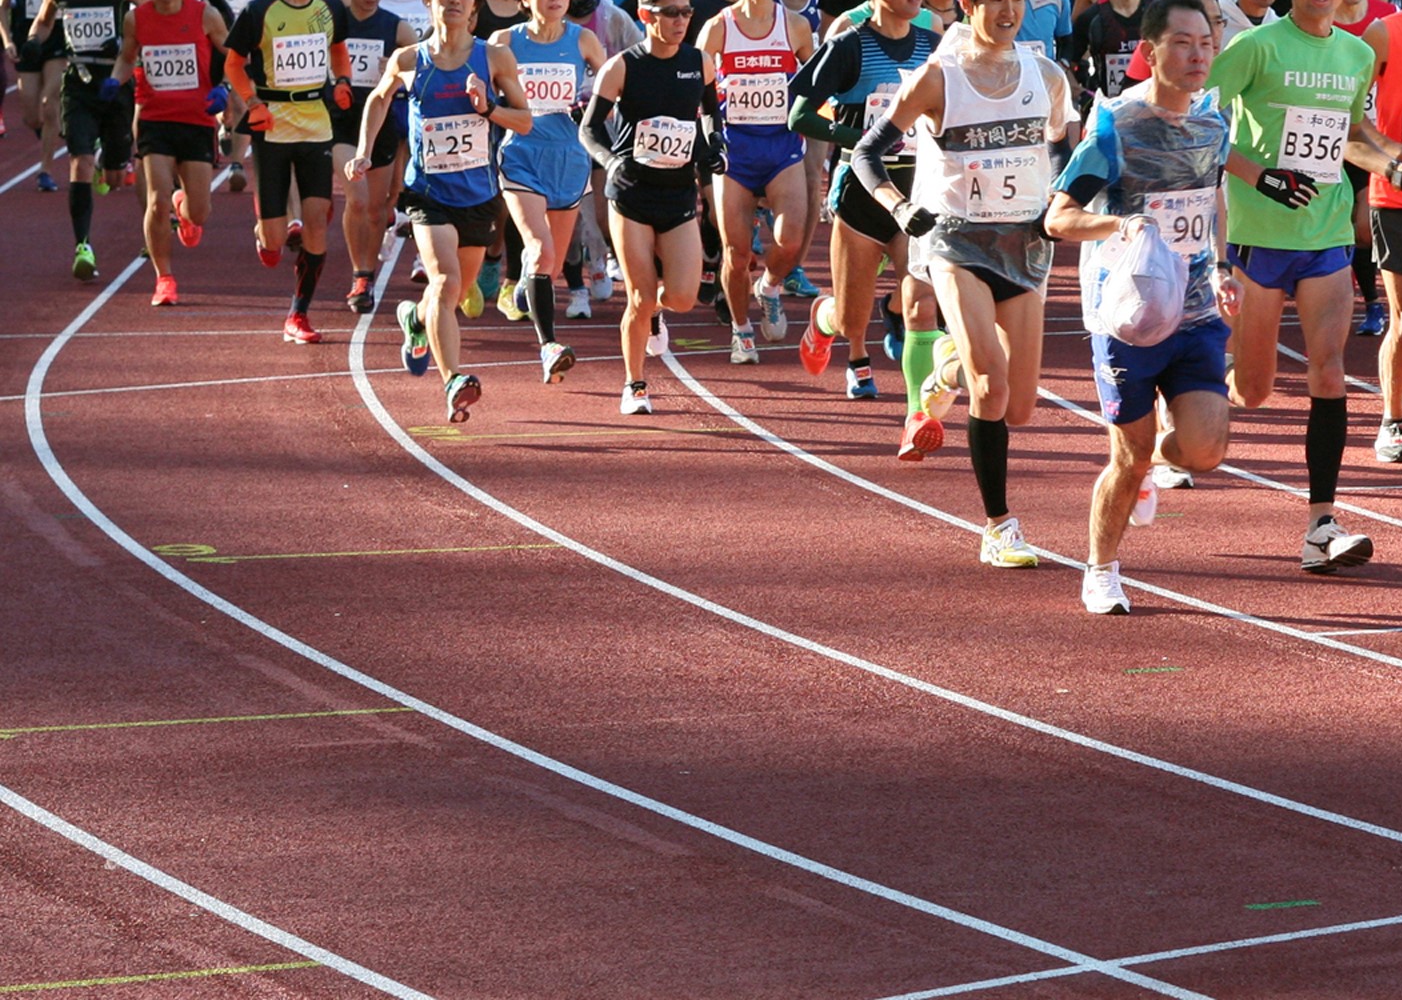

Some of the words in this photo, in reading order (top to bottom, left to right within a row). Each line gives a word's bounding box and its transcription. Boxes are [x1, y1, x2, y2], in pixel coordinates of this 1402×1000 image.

[146, 59, 196, 77] A2028
[276, 49, 327, 71] A4012
[734, 56, 782, 69] 日本精工
[525, 80, 574, 100] 8002
[1283, 70, 1356, 92] FUJIFILM
[728, 90, 786, 109] A4003
[426, 139, 437, 157] A
[446, 134, 473, 155] 25
[637, 131, 692, 159] A2024
[963, 120, 1042, 150] 静岡大学
[1283, 131, 1342, 162] B356
[969, 176, 982, 200] A
[1002, 175, 1017, 200] 5
[1173, 214, 1204, 243] 90
